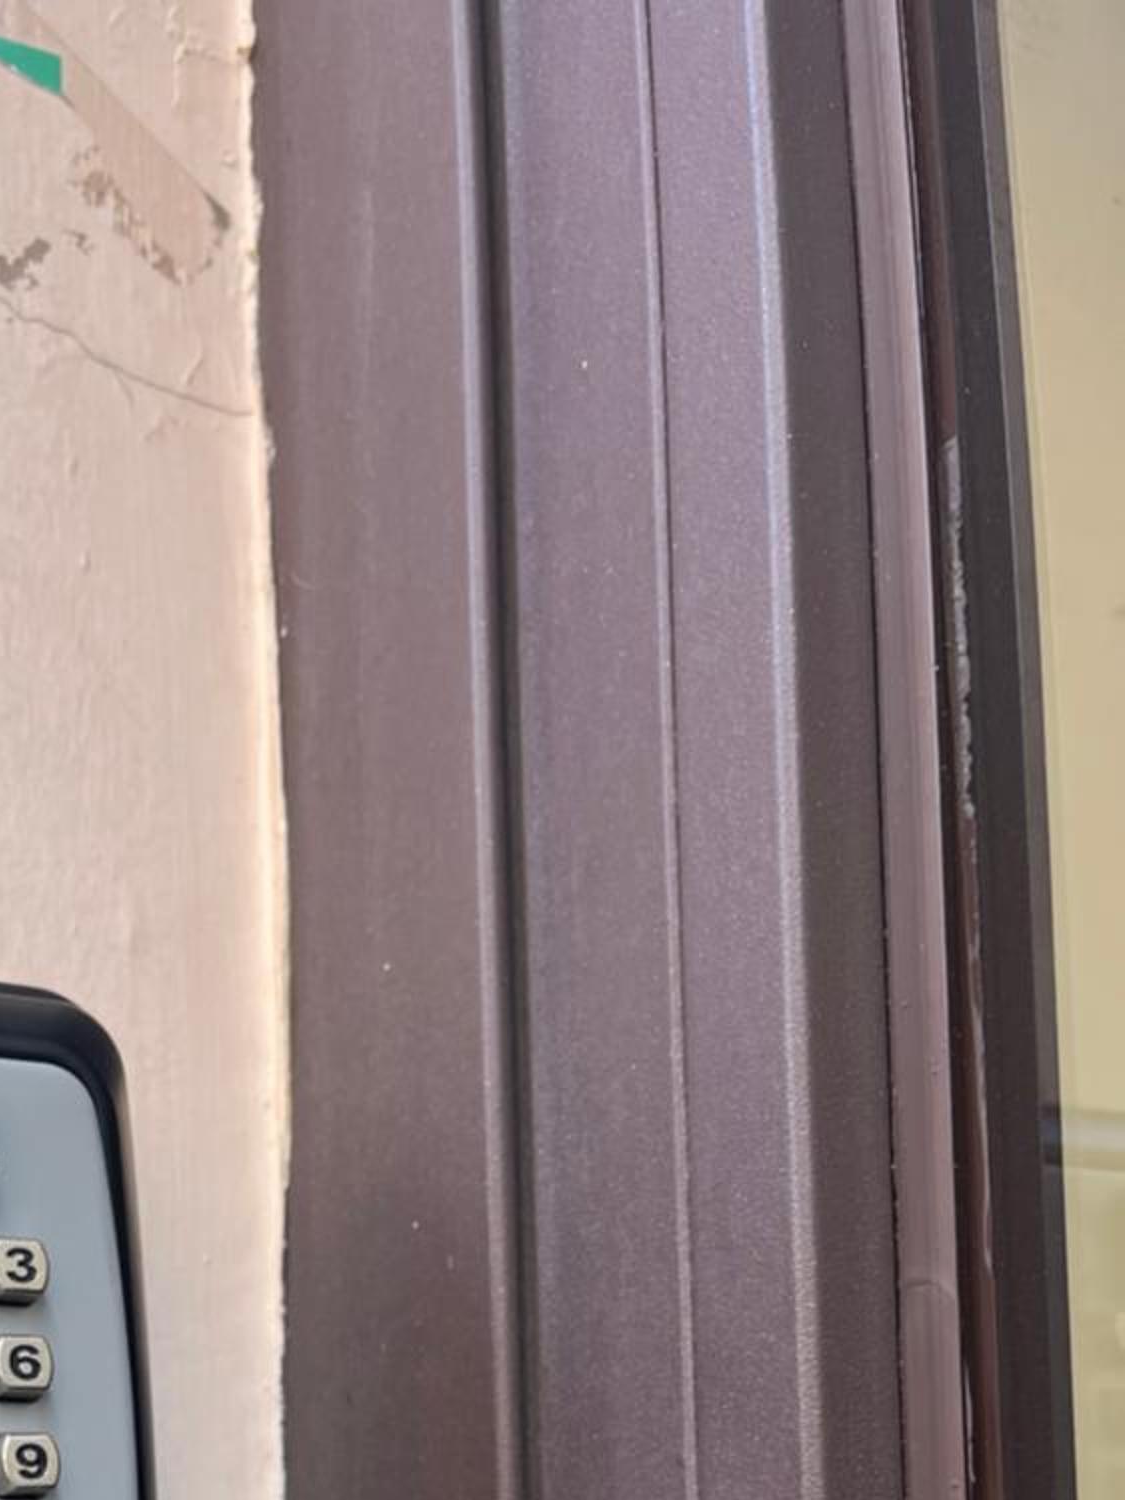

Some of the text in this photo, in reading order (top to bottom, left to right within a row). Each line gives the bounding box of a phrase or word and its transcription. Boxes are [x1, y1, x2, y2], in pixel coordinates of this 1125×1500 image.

[7, 1248, 36, 1282] 3
[9, 1345, 40, 1380] 6
[16, 1444, 47, 1479] 9
